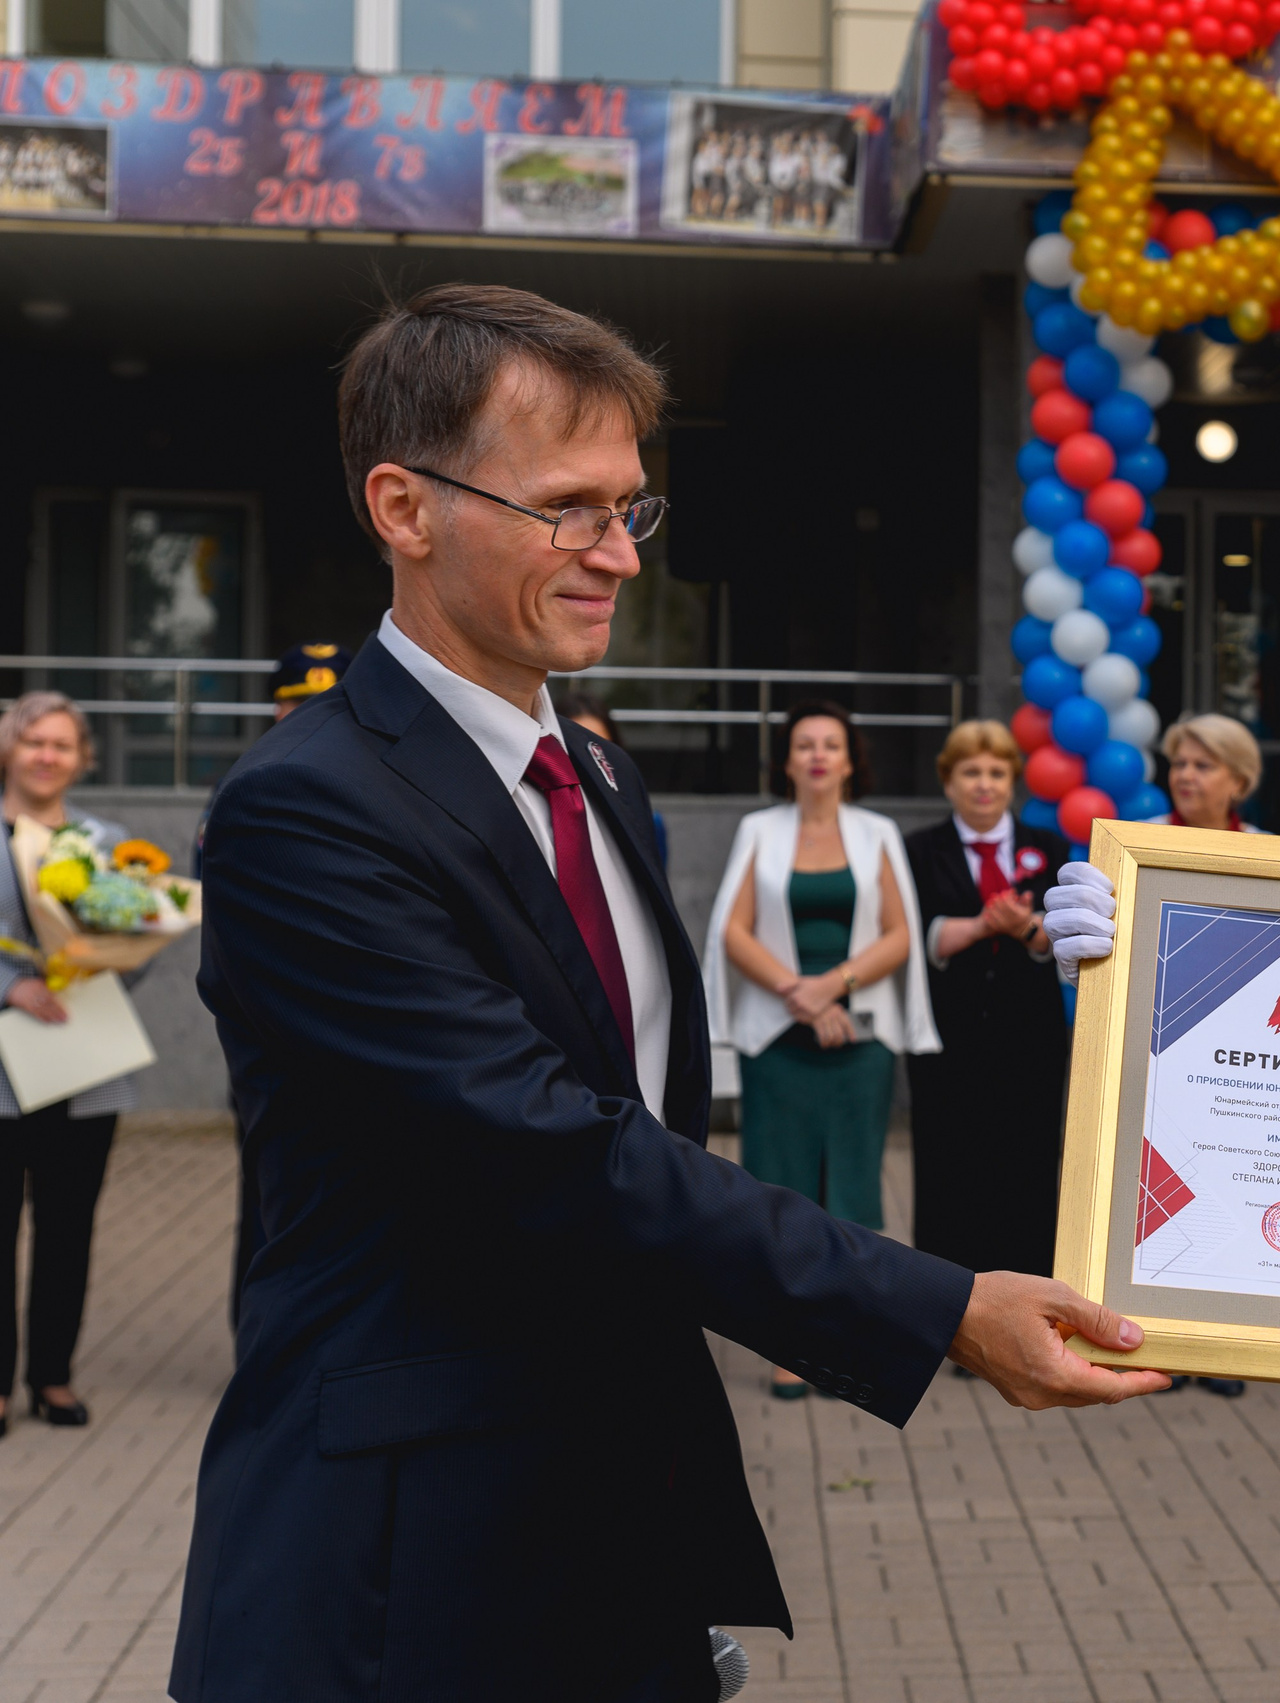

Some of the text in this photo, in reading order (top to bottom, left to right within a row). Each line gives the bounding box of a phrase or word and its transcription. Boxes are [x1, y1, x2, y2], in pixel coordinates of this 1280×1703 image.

[251, 178, 361, 227] 2018
[1187, 1074, 1194, 1083] О
[1196, 1074, 1264, 1091] ПРИСВОЕНИИ
[1214, 1095, 1270, 1108] Юнармейский
[1210, 1107, 1262, 1120] Пушкинского
[1192, 1141, 1216, 1152] Героя
[1217, 1144, 1262, 1156] Советского
[1232, 1173, 1275, 1186] СТЕПАНА
